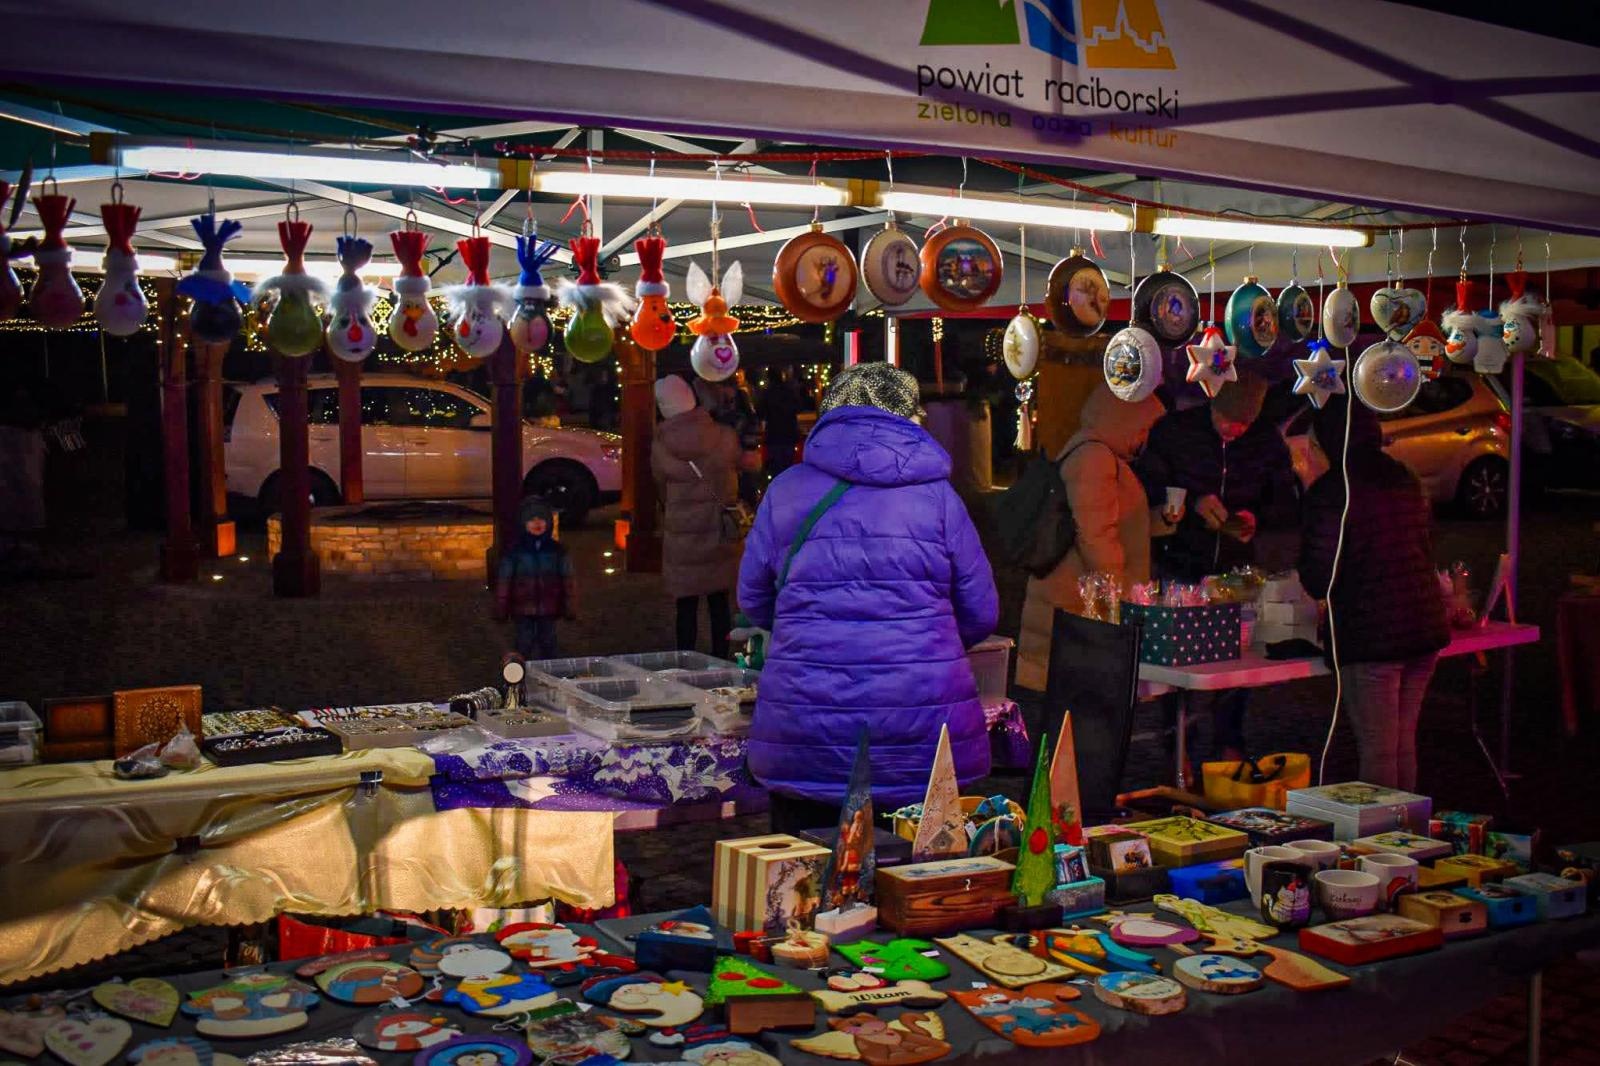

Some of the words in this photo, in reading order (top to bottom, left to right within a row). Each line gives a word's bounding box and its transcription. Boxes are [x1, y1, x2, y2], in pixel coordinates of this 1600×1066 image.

[917, 63, 1024, 98] powiat
[1045, 76, 1179, 120] raciborski
[917, 102, 1012, 128] zielona
[1109, 122, 1178, 148] kultur
[848, 991, 912, 1002] Witam
